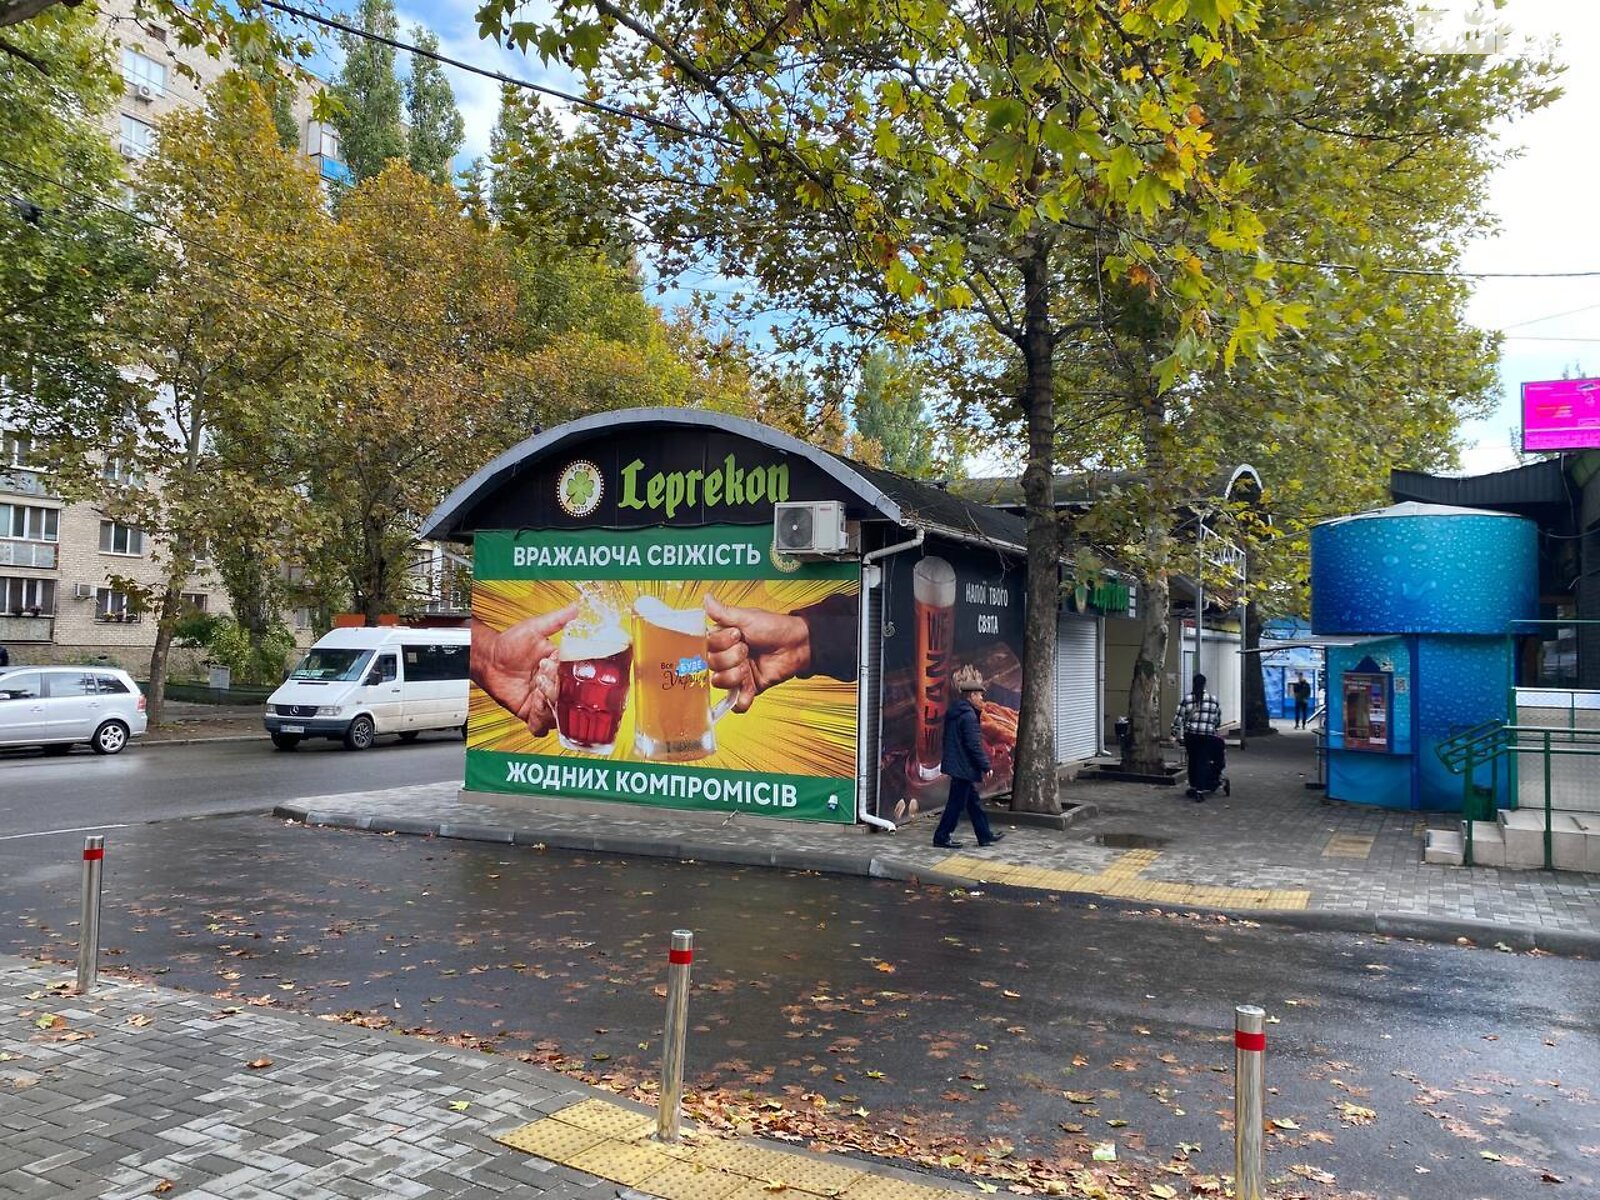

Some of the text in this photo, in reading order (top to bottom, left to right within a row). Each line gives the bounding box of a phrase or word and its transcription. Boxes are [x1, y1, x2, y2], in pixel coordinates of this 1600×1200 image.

[618, 453, 789, 518] Leprekon
[513, 543, 761, 567] ВРАЖАЮЧА СВІЖІСТЬ
[965, 580, 1009, 608] НАПОЇ ТВОГО
[978, 614, 999, 635] СВЯТА
[505, 760, 797, 807] ЖОДНИХ КОМПРОМІСІВ
